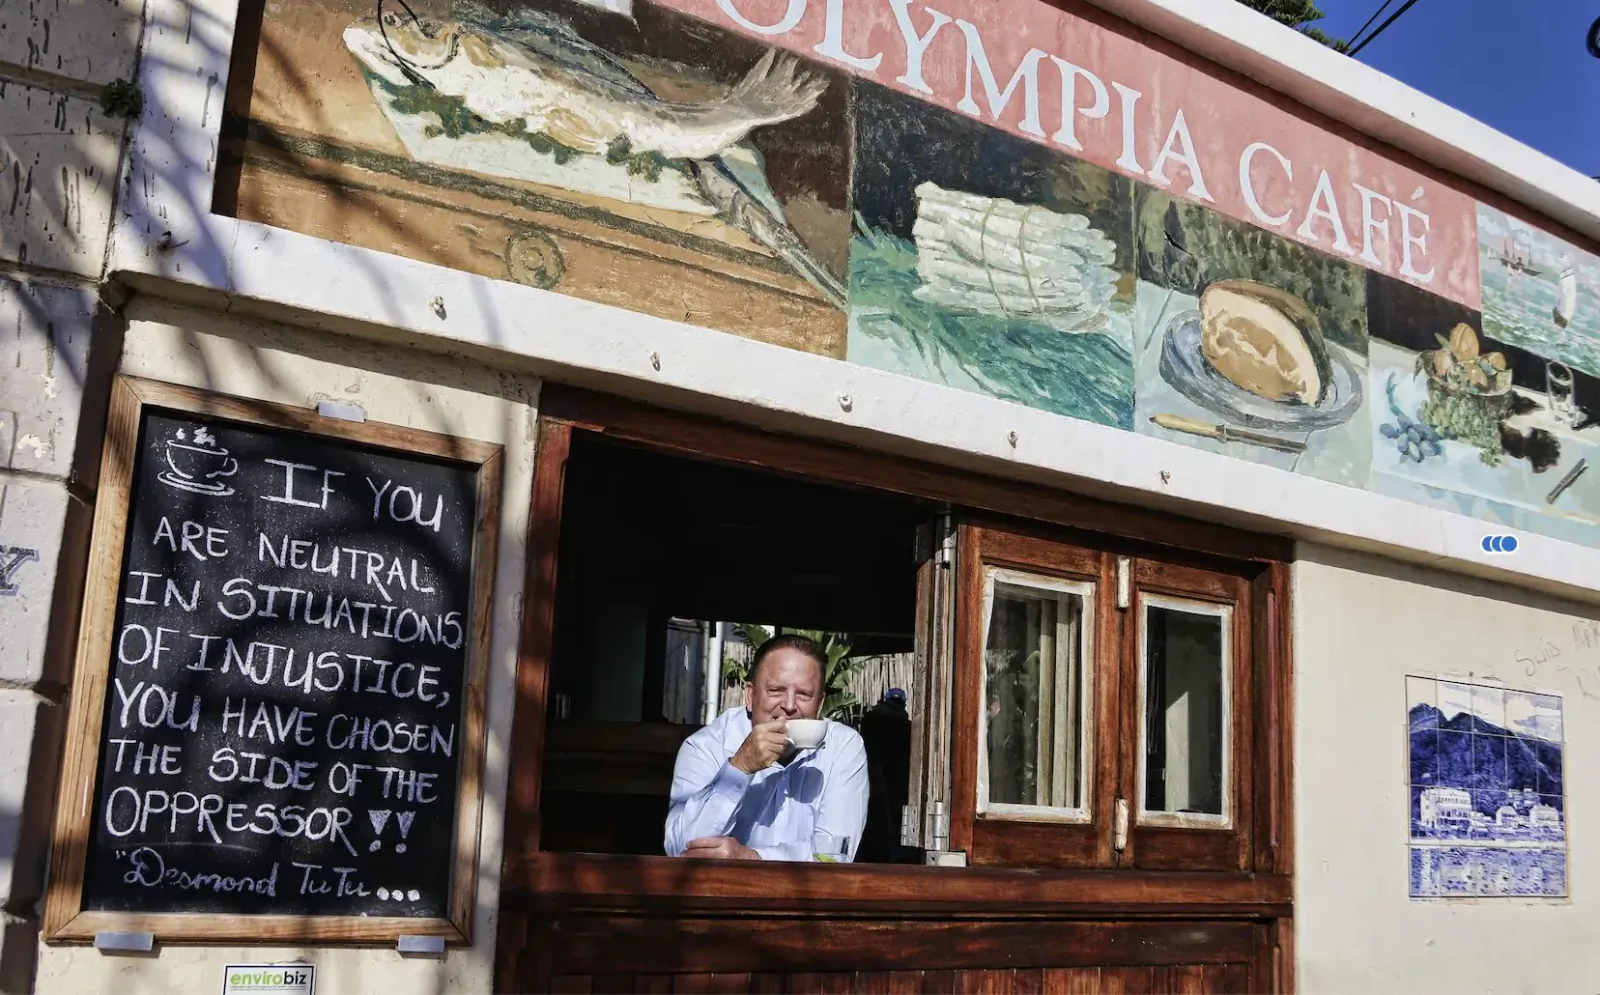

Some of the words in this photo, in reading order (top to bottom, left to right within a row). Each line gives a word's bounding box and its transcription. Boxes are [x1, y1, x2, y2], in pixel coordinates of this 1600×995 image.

[1239, 142, 1436, 284] CAFÉ
[260, 458, 345, 509] IF
[366, 476, 443, 532] YOU
[153, 517, 229, 561] ARE
[259, 532, 435, 602] NEUTRAL
[125, 571, 199, 613] IN
[218, 577, 463, 649] SITUATIONS
[119, 624, 181, 670] OF
[187, 635, 451, 708] INJUSTICE,
[114, 678, 200, 731] YOU
[222, 697, 317, 747] HAVE
[327, 713, 454, 758] CHOSEN
[110, 739, 182, 776] THE
[208, 748, 319, 791] SIDE
[329, 761, 373, 797] OF
[374, 766, 438, 803] THE
[105, 786, 359, 857] OPPRESSOR
[230, 971, 307, 985] envirobiz
